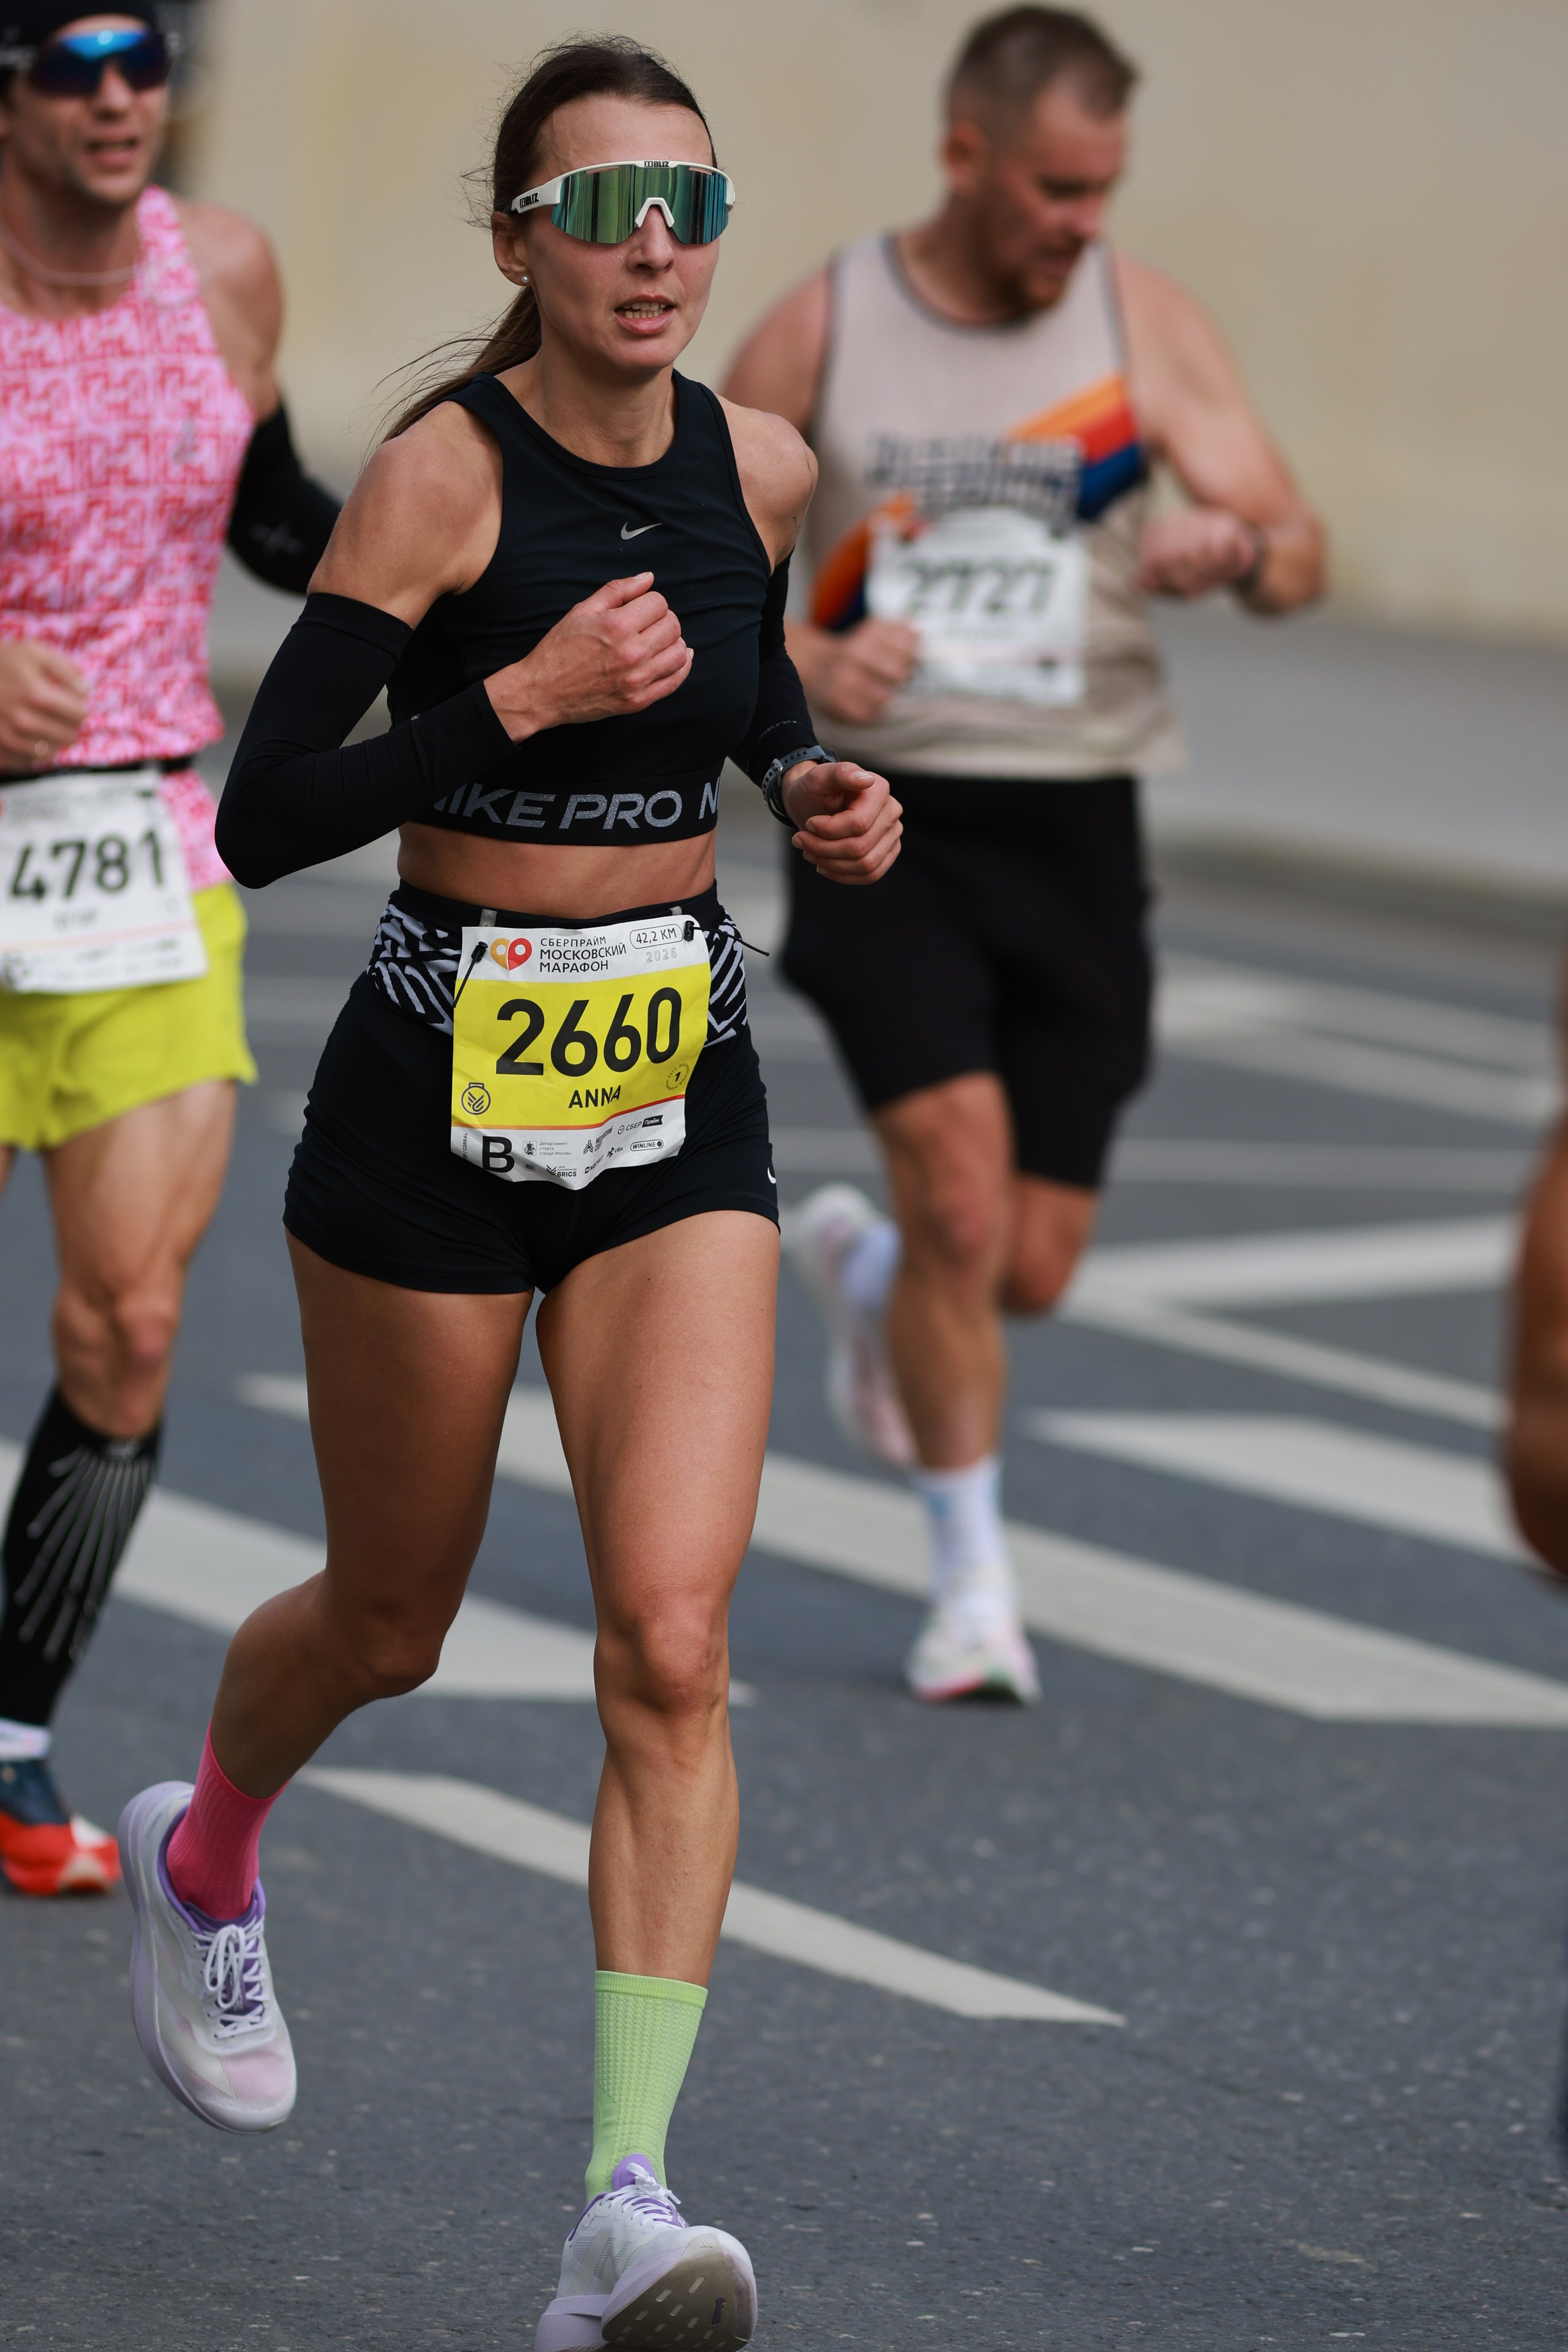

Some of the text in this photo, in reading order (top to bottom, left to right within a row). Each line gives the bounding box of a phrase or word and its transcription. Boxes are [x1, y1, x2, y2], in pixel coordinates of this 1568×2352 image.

[559, 790, 682, 829] PRO
[11, 828, 164, 899] 4781
[540, 936, 606, 948] СБЕРПРАЙМ
[636, 930, 658, 944] 42,2
[540, 942, 627, 960] МОСКОВСКИЙ
[647, 948, 677, 963] 2026
[540, 960, 608, 973] МАРАФОН
[496, 987, 682, 1077] 2660
[675, 1071, 681, 1082] 1
[568, 1085, 621, 1109] ANNA
[626, 1121, 643, 1131] СБЕР
